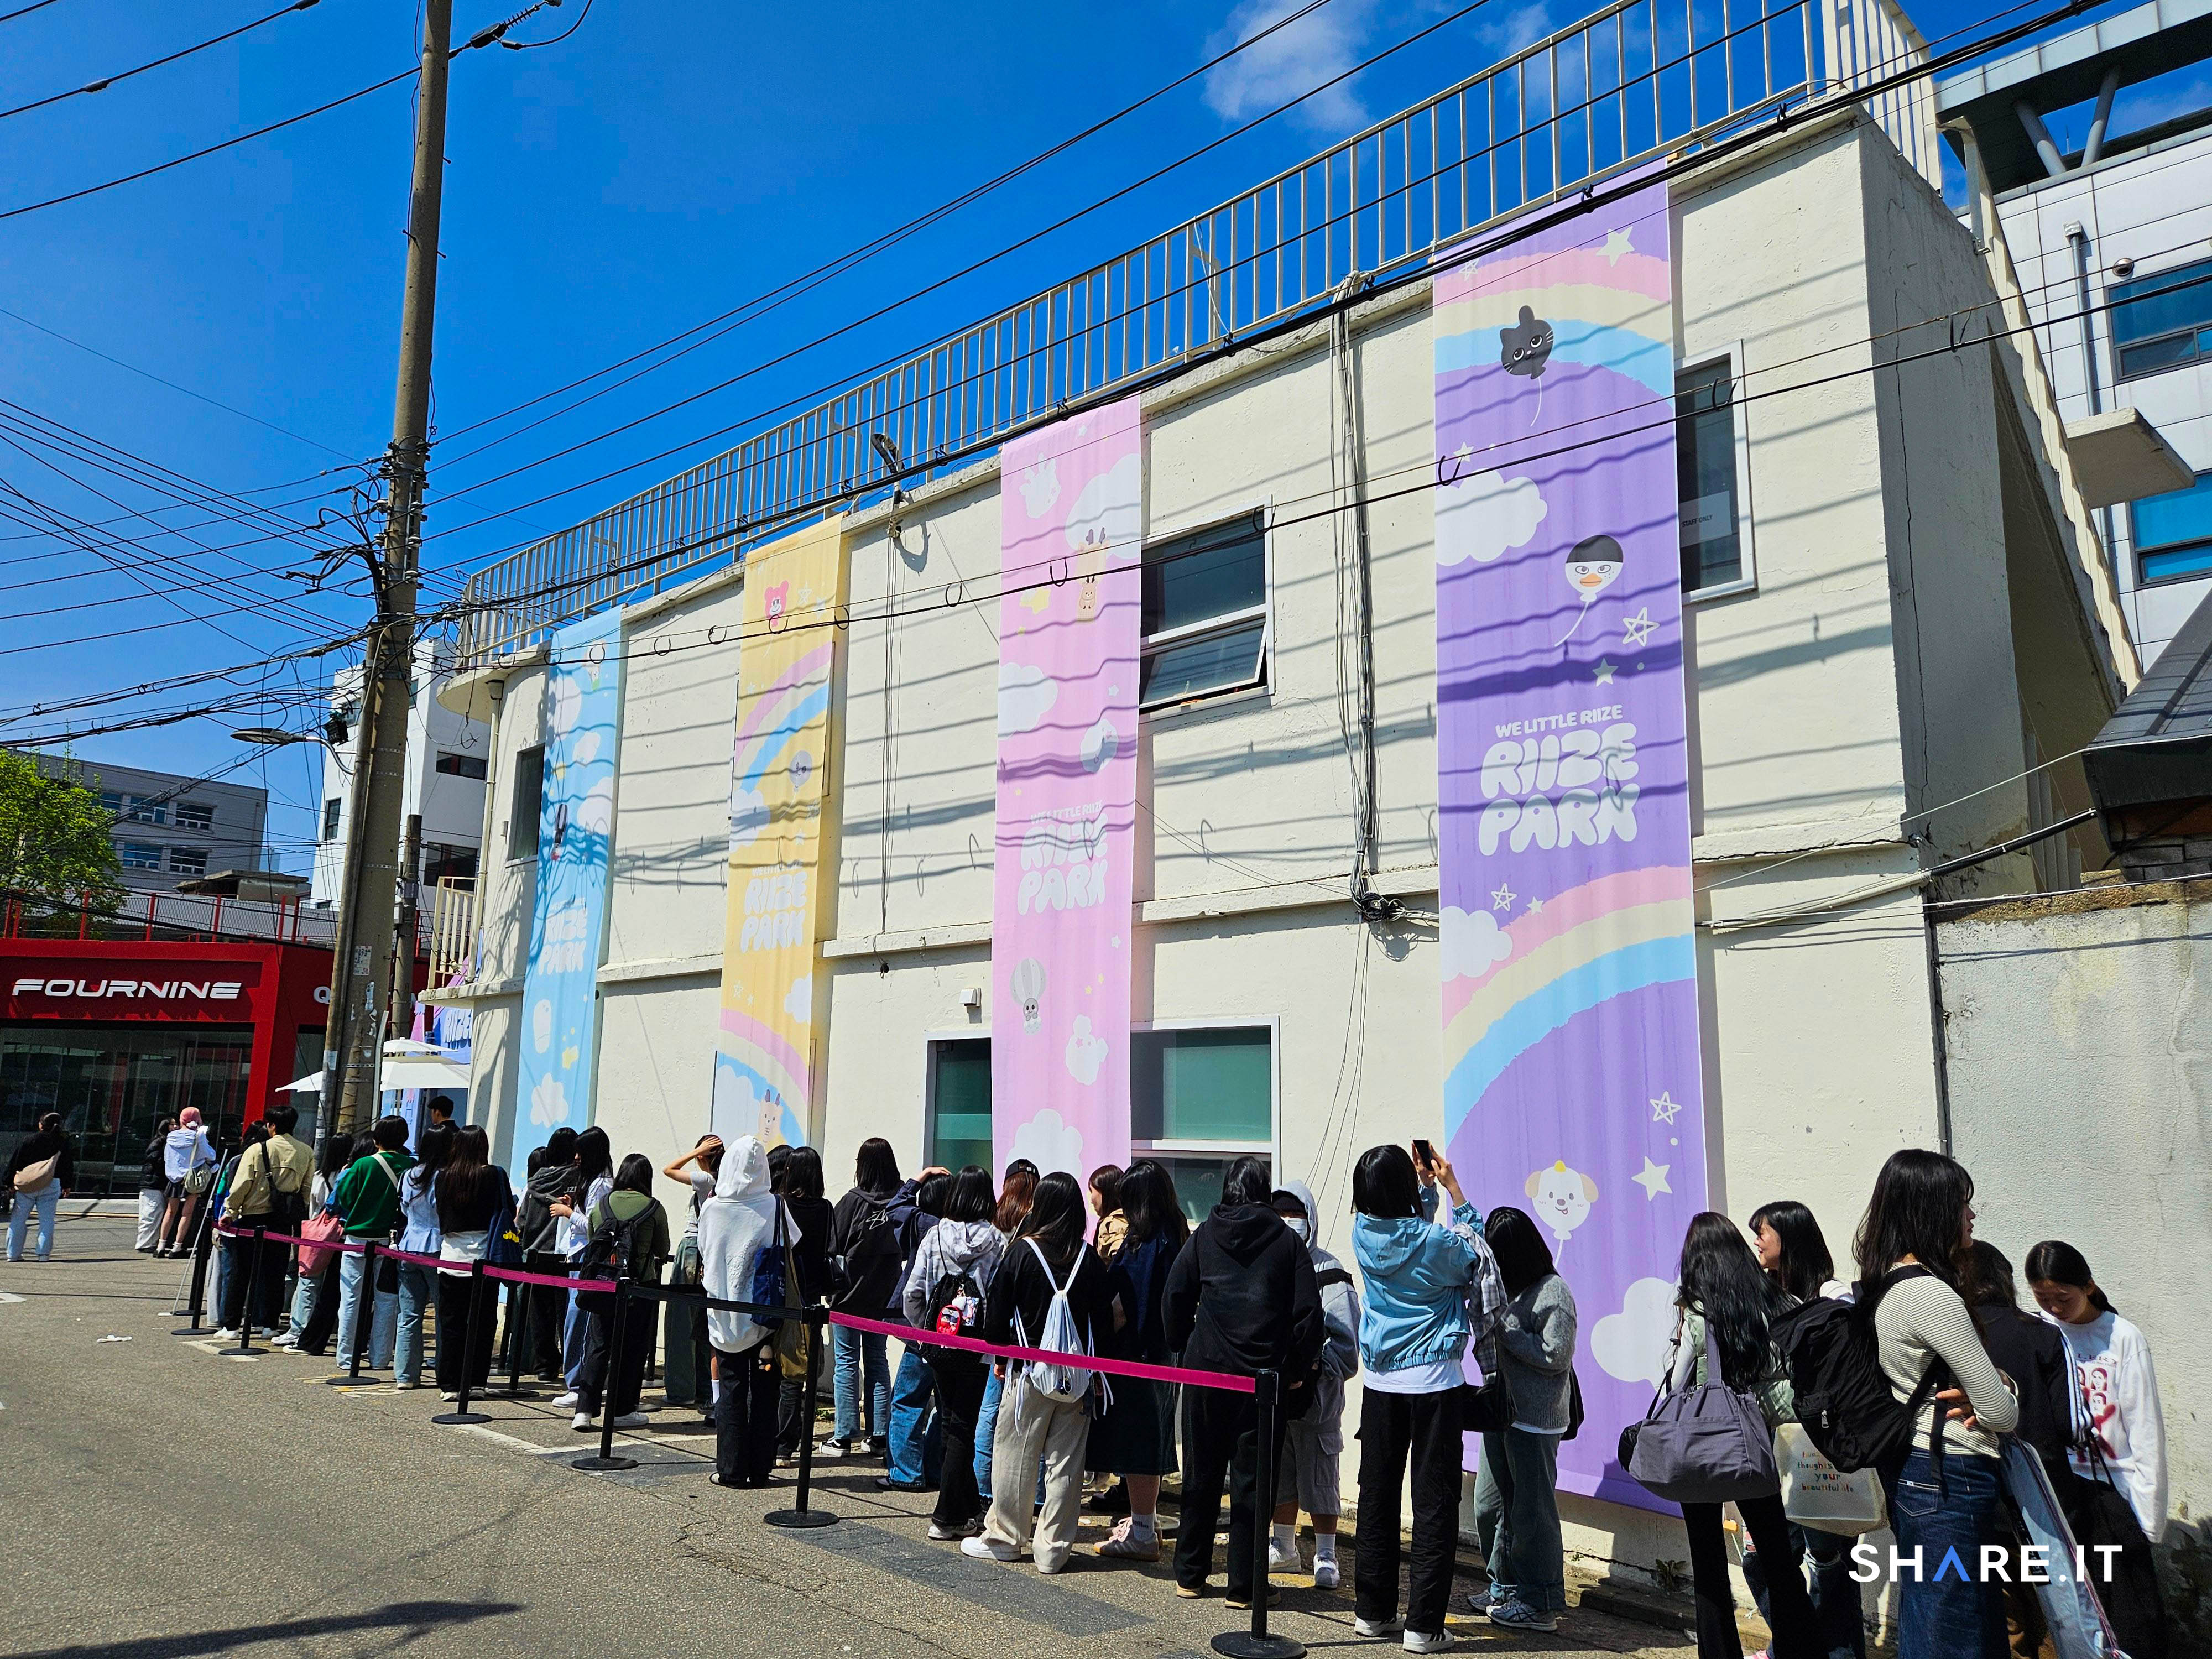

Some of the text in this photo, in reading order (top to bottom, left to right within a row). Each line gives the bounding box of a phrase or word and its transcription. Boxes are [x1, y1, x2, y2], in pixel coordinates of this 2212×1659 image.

[1682, 514, 1713, 528] STAFF ONLY
[1495, 705, 1623, 738] WE LITTLE RIIZE
[1480, 722, 1640, 799] RIIZE
[1047, 806, 1082, 821] LITTLE
[1479, 783, 1641, 856] PARK
[1020, 813, 1108, 871] RIIZE
[744, 870, 808, 916] RIIZE
[1017, 859, 1108, 916] PARK
[544, 907, 588, 946] RIIZE
[740, 909, 806, 954] PARK
[538, 940, 587, 976] PARK
[12, 979, 242, 999] FOURNINE
[1814, 1473, 1841, 1482] your
